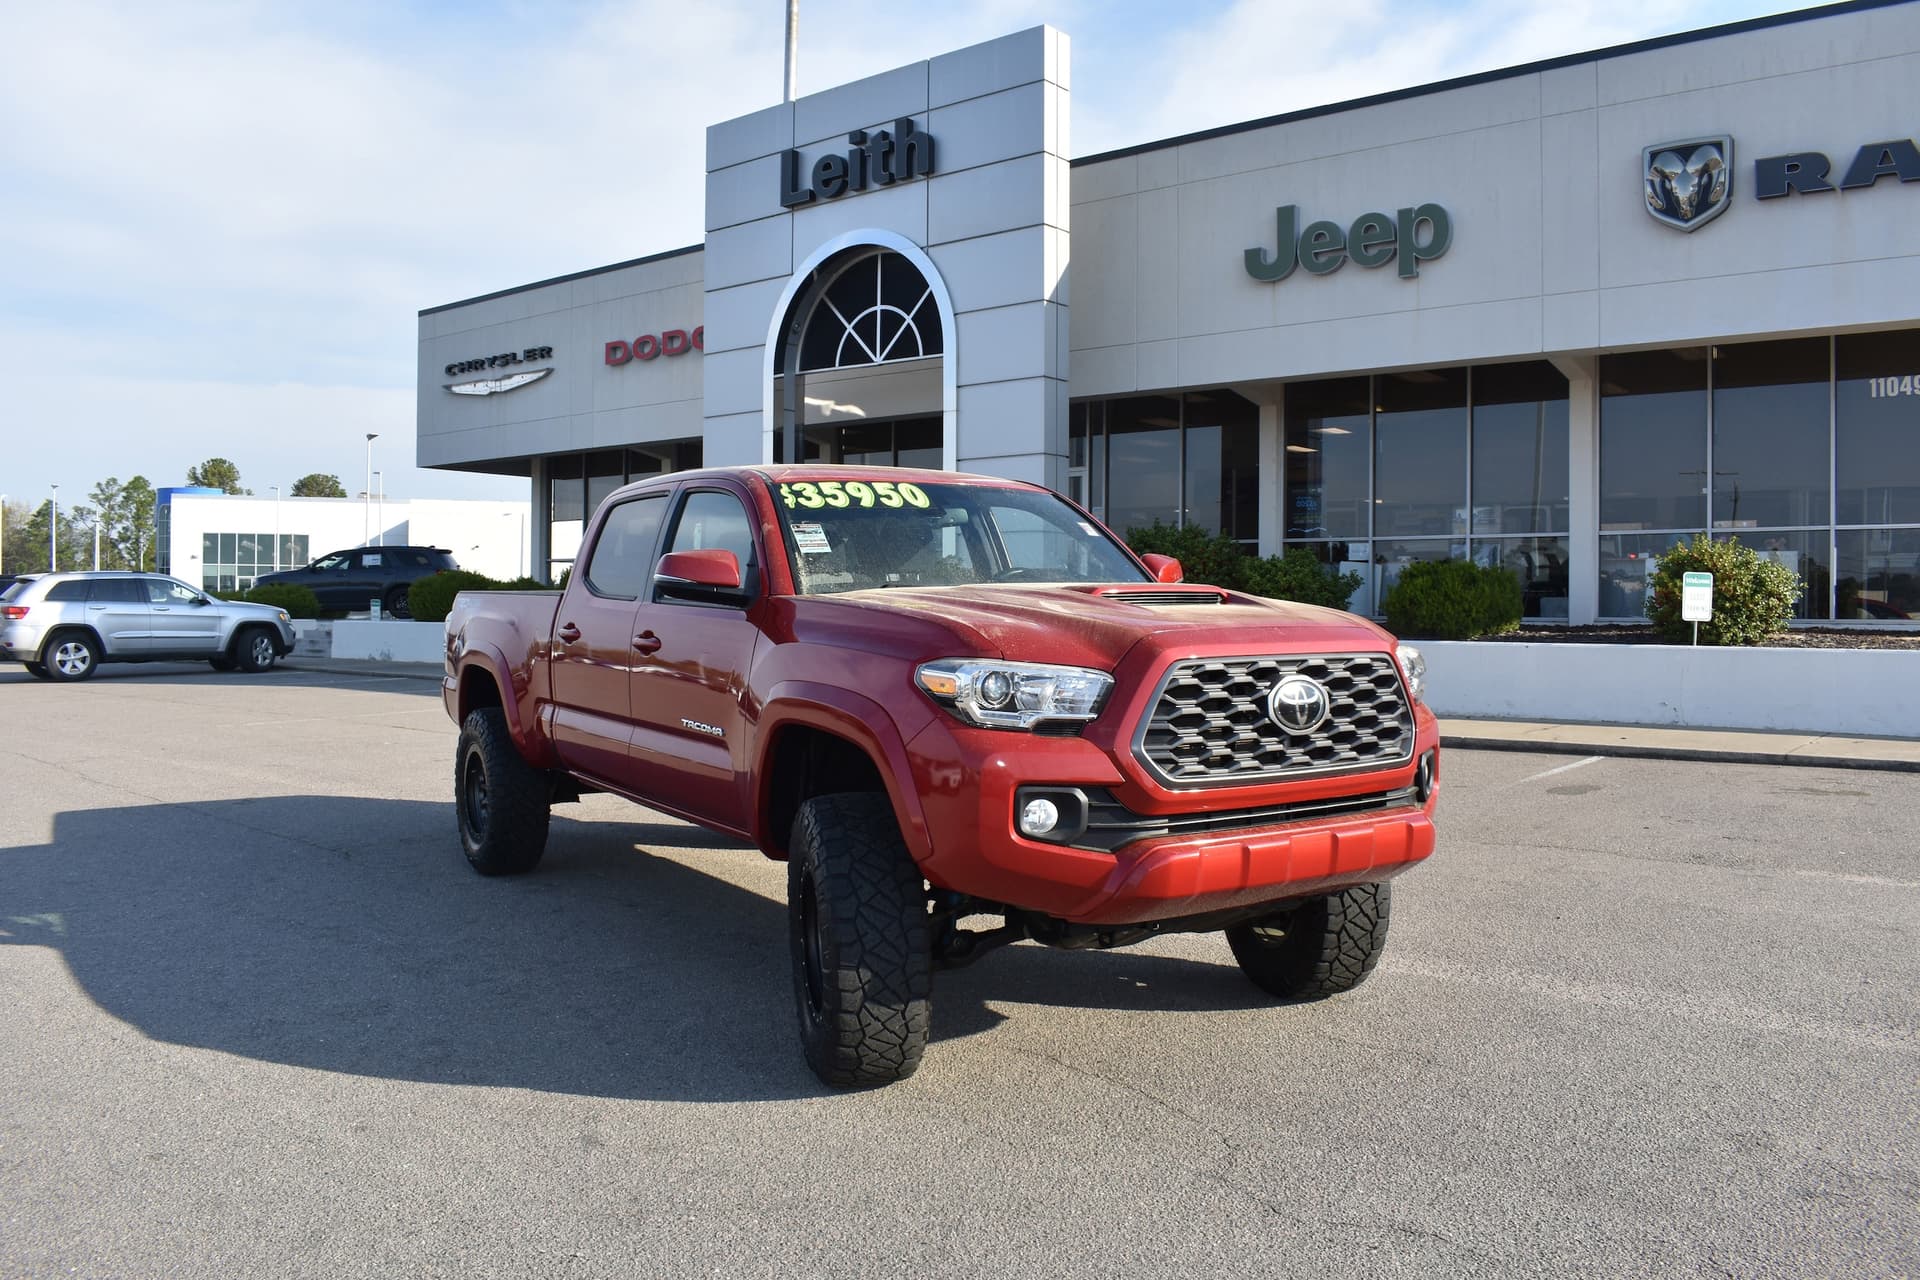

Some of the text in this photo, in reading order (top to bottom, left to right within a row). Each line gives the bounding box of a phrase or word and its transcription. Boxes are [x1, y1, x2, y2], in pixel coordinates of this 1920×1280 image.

[780, 117, 935, 209] Leith
[1244, 203, 1453, 282] Jeep
[445, 345, 553, 376] CHRYSLER
[780, 481, 930, 509] $35950
[680, 718, 724, 737] TACOMA
